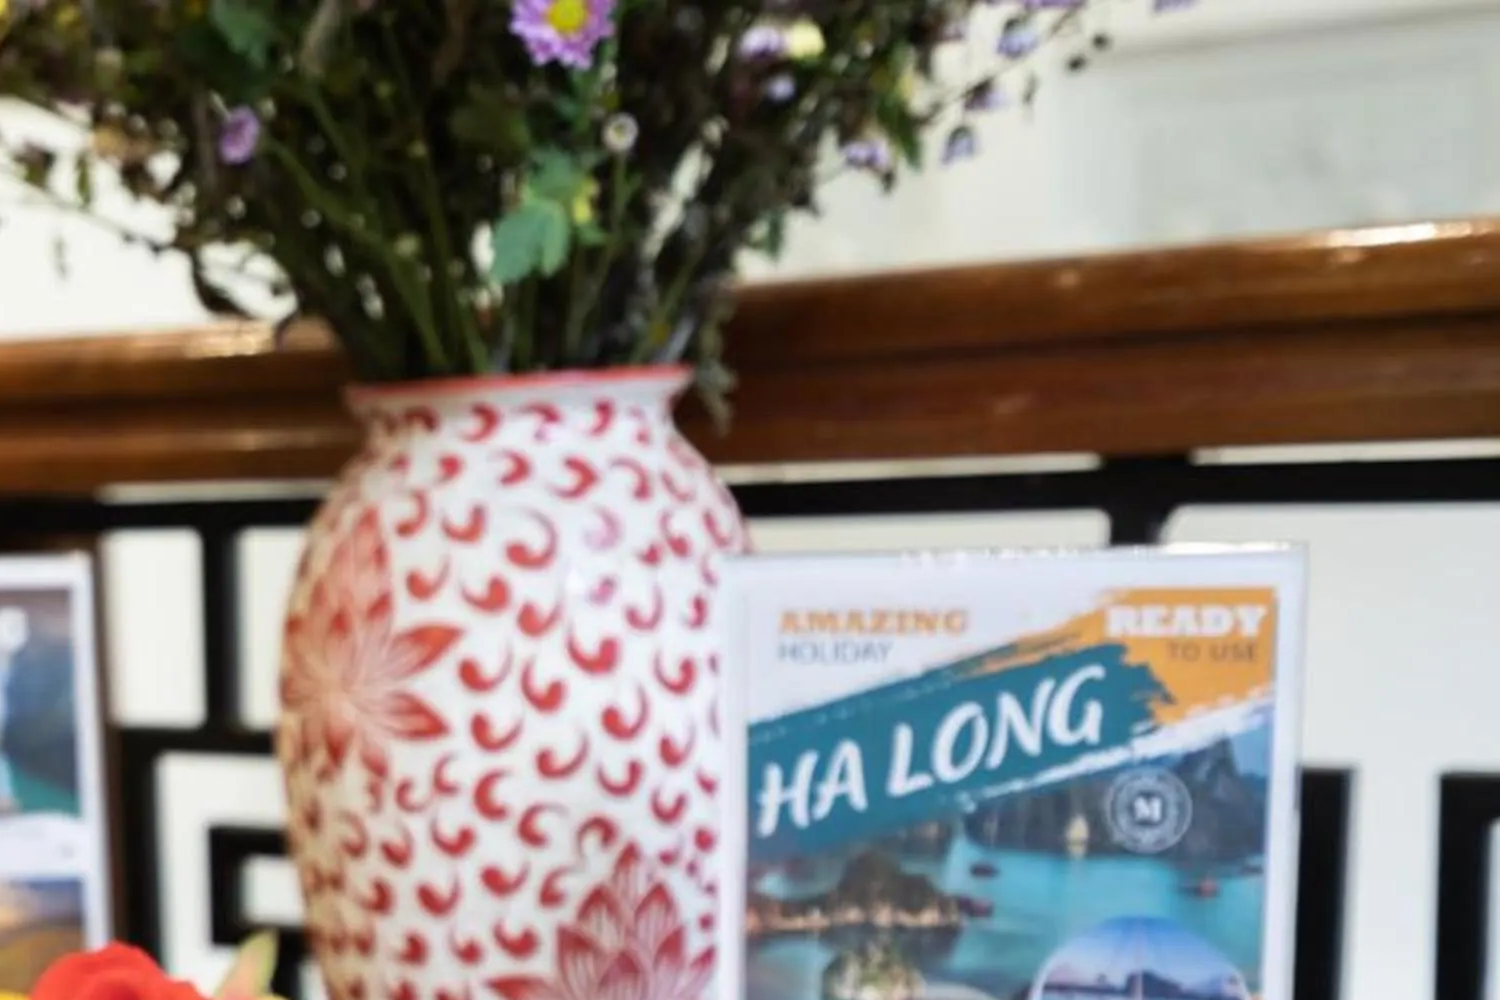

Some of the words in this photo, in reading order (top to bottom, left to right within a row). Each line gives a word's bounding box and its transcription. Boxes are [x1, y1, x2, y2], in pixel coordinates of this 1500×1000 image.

[777, 608, 970, 637] AMAZING
[1106, 605, 1267, 636] READY
[778, 640, 895, 664] HOLIDAY
[1167, 641, 1200, 663] TO
[1210, 641, 1257, 663] USE
[756, 740, 868, 836] HA
[887, 664, 1106, 797] LONG
